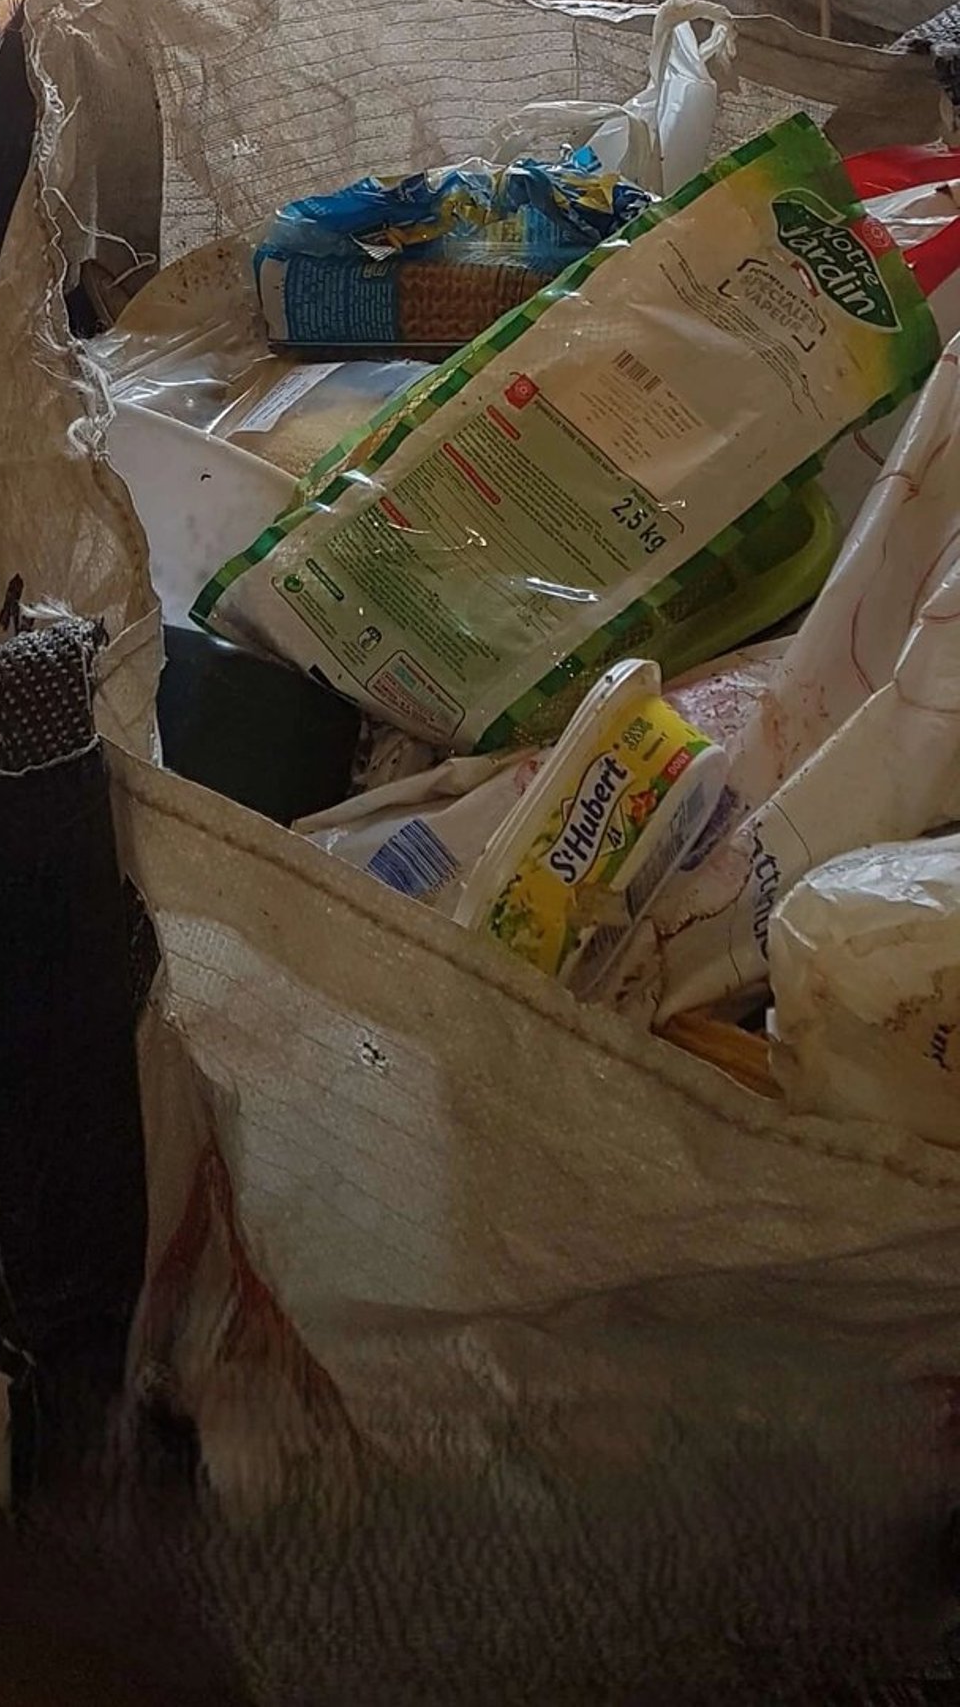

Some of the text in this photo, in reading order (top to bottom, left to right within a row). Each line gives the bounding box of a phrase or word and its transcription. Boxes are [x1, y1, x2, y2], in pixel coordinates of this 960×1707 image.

[780, 225, 876, 315] Jardin
[809, 226, 879, 287] Notre
[610, 497, 667, 554] 2,5 kg
[607, 827, 623, 849] 41
